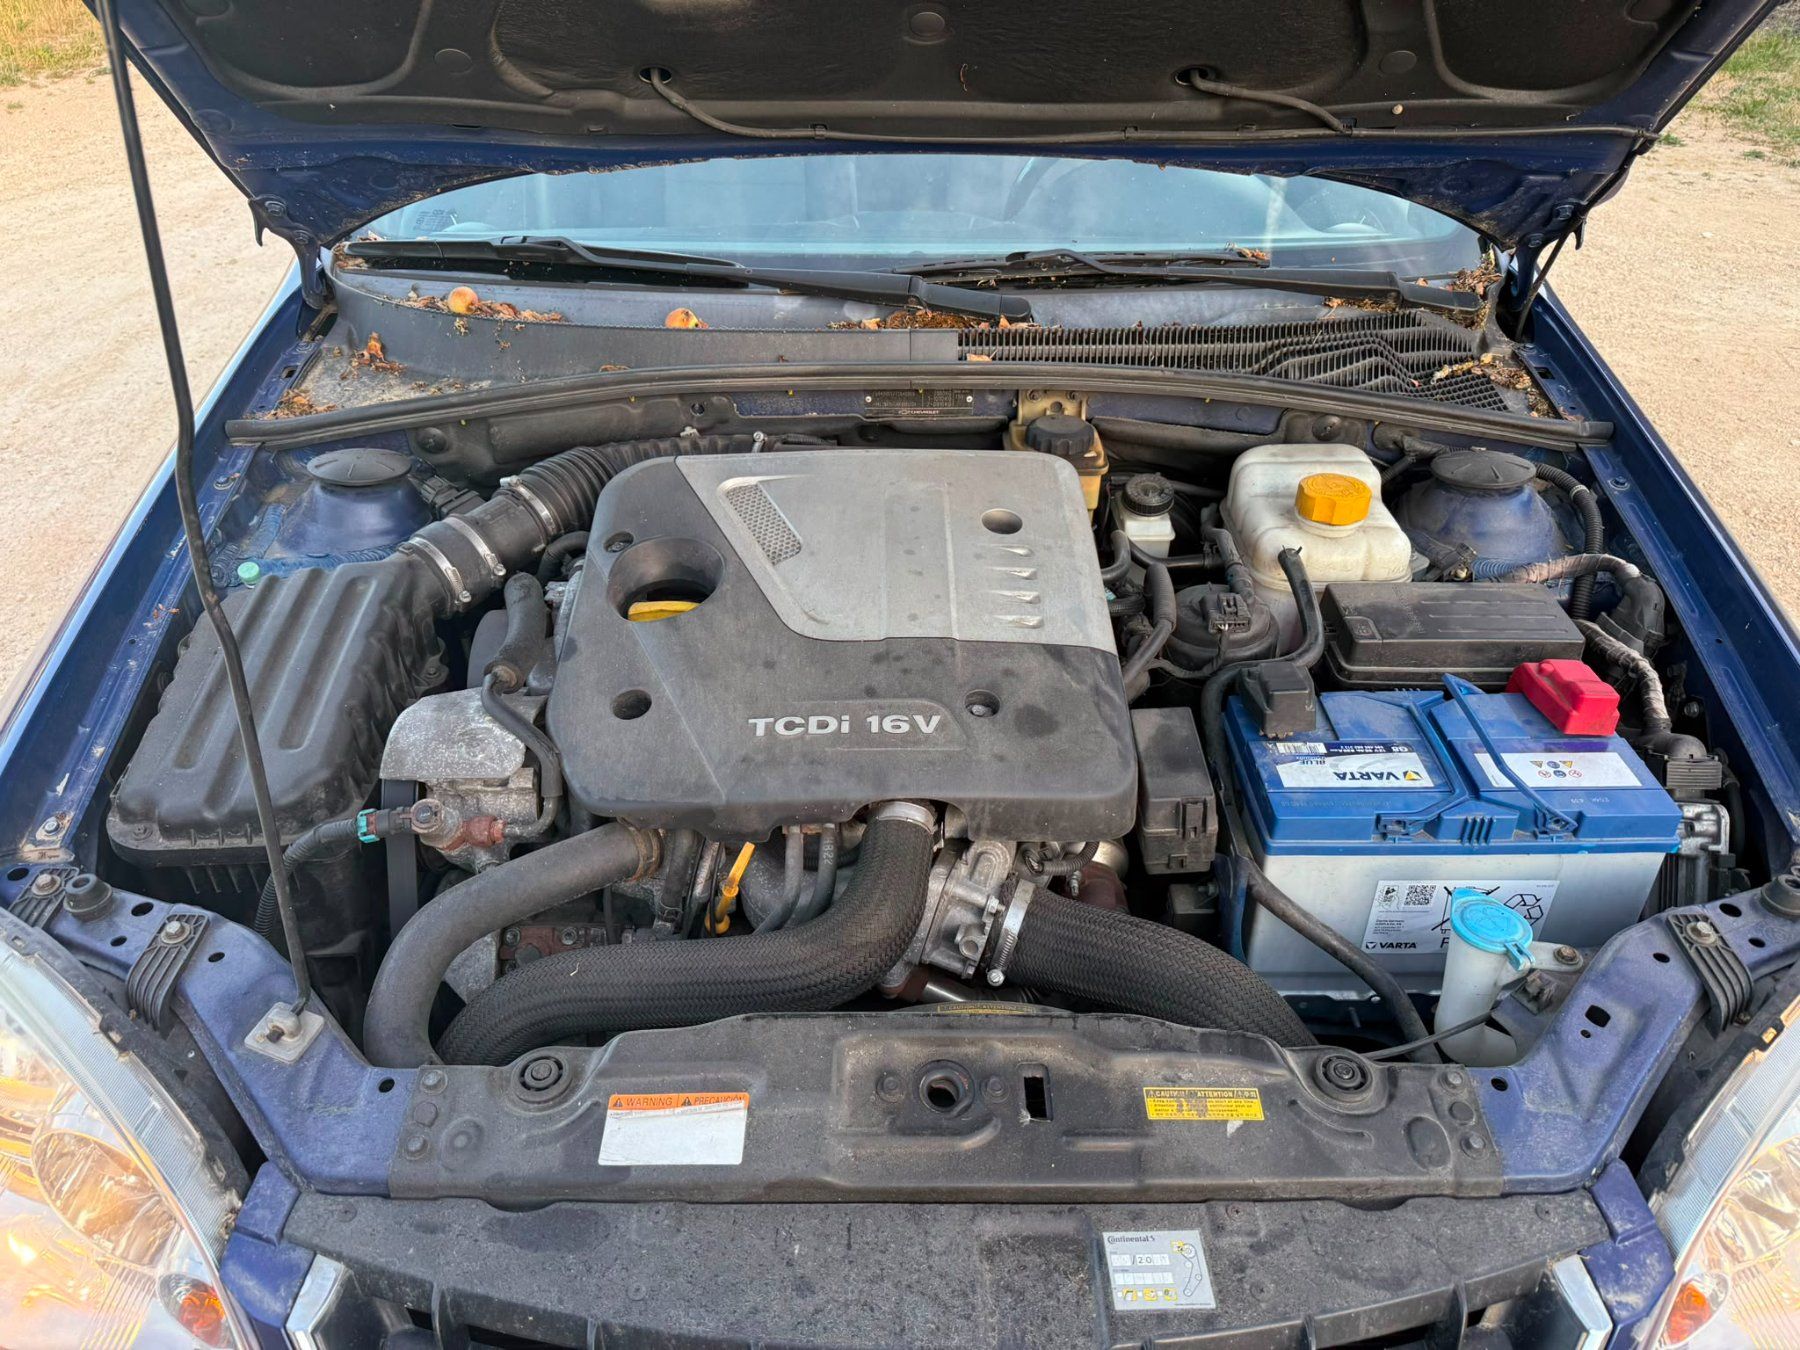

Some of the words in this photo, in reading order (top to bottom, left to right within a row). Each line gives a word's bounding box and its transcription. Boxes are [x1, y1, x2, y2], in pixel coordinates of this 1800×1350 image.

[748, 715, 850, 737] TCDi
[866, 715, 942, 735] 16V
[1334, 771, 1400, 781] VARTA
[626, 1097, 673, 1107] WARNING
[1107, 1235, 1149, 1245] Continental
